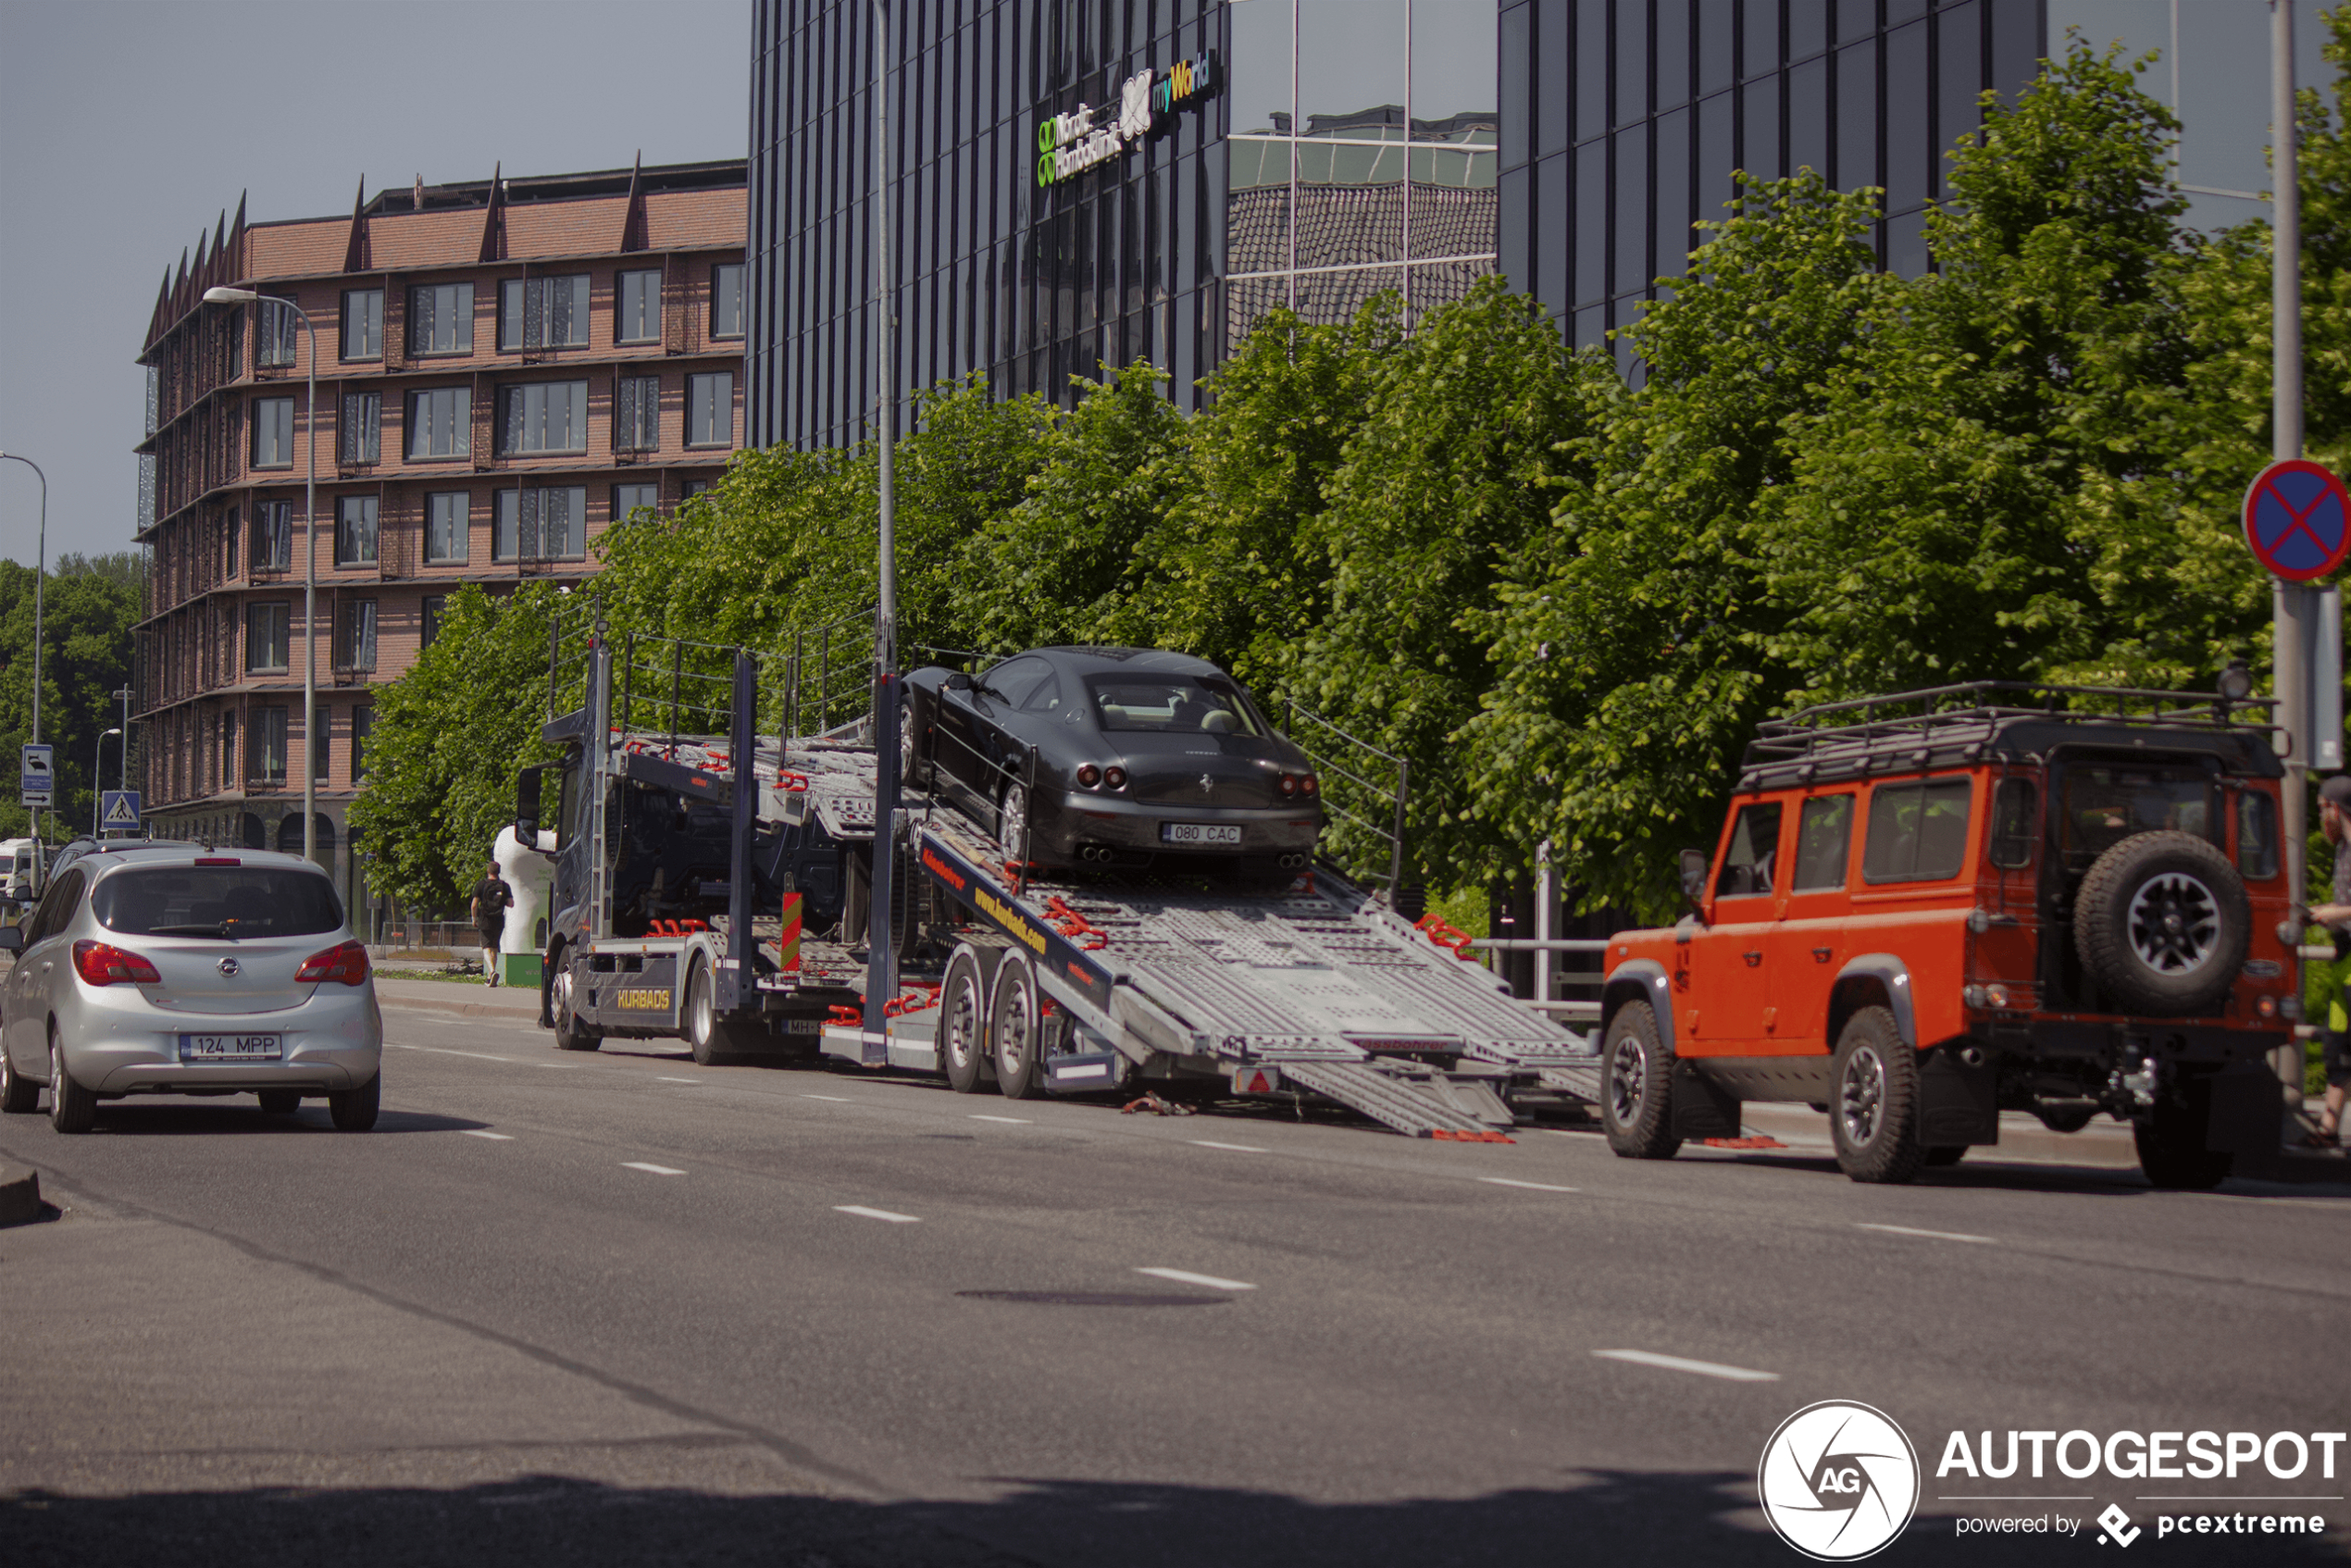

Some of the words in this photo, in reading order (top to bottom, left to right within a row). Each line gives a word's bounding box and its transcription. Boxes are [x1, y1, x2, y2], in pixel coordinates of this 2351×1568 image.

[1152, 52, 1209, 112] myWorld
[1056, 103, 1093, 146] Nordic
[1176, 827, 1200, 840] 080
[1207, 828, 1237, 840] CAC
[617, 989, 670, 1010] KURBADS
[198, 1038, 224, 1053] 124
[236, 1038, 275, 1053] MPP
